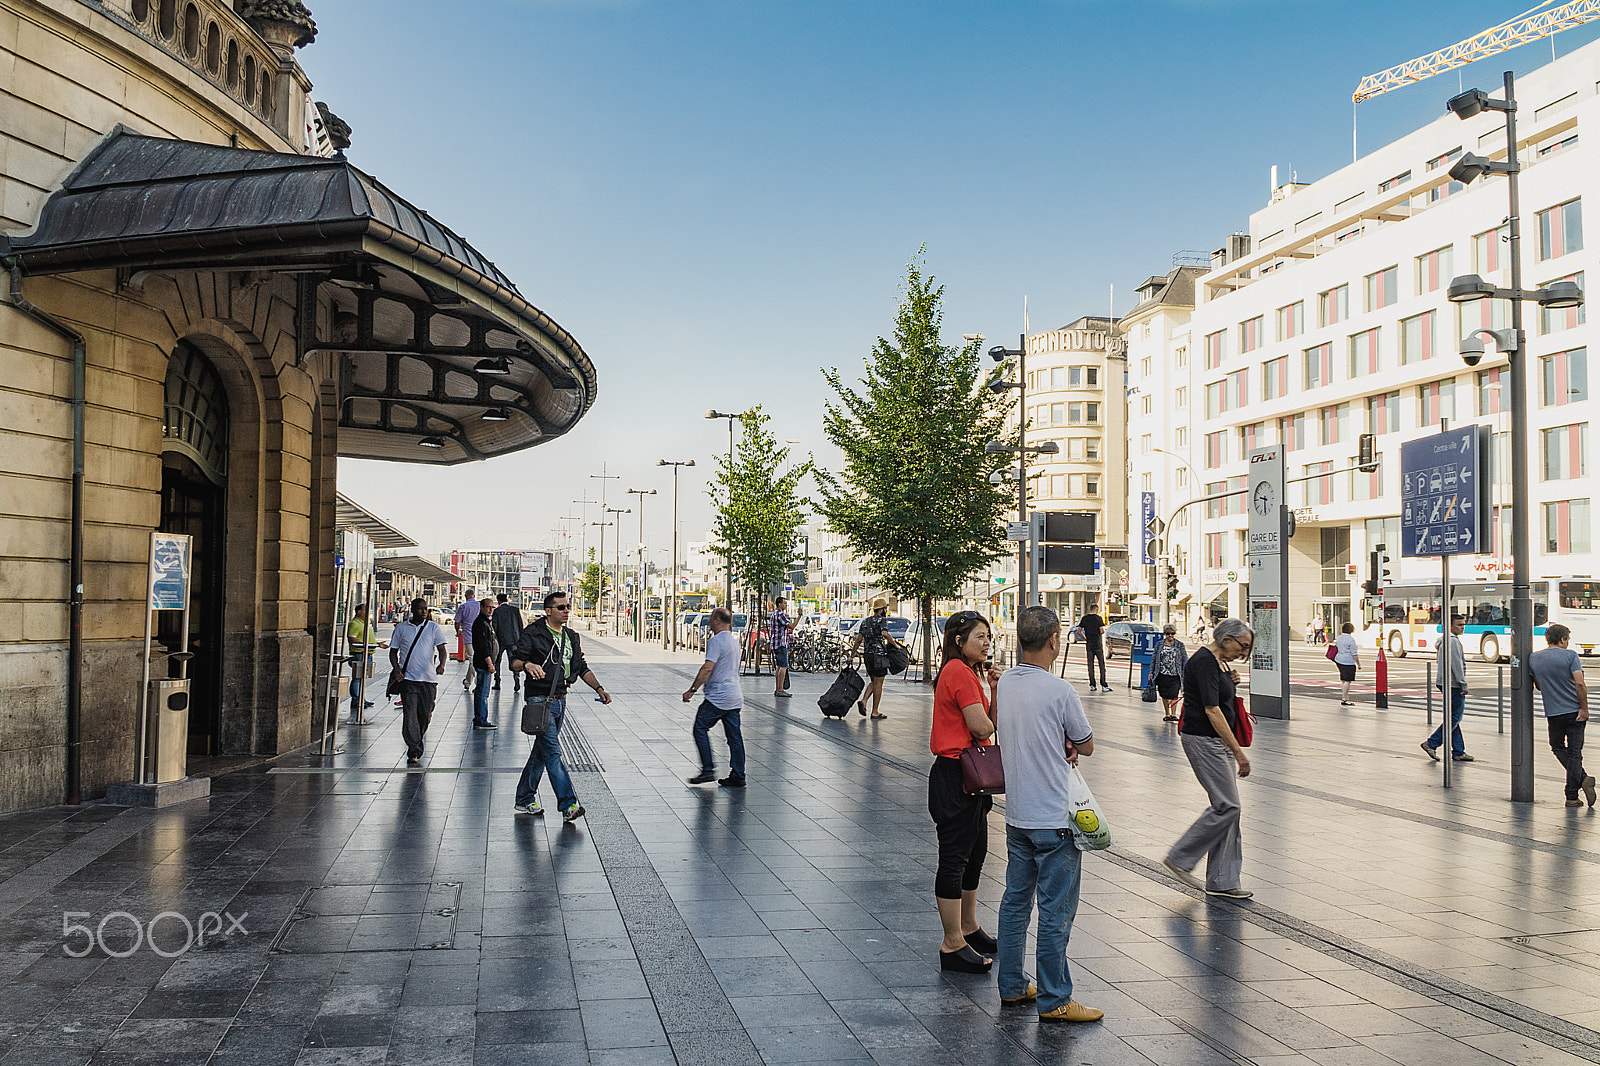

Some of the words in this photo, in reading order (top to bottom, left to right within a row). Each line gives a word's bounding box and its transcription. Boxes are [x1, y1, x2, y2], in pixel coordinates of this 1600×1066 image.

[1250, 533, 1268, 543] GARE
[1268, 532, 1278, 541] DE
[1430, 534, 1442, 546] WC
[1474, 560, 1514, 573] VAPIN
